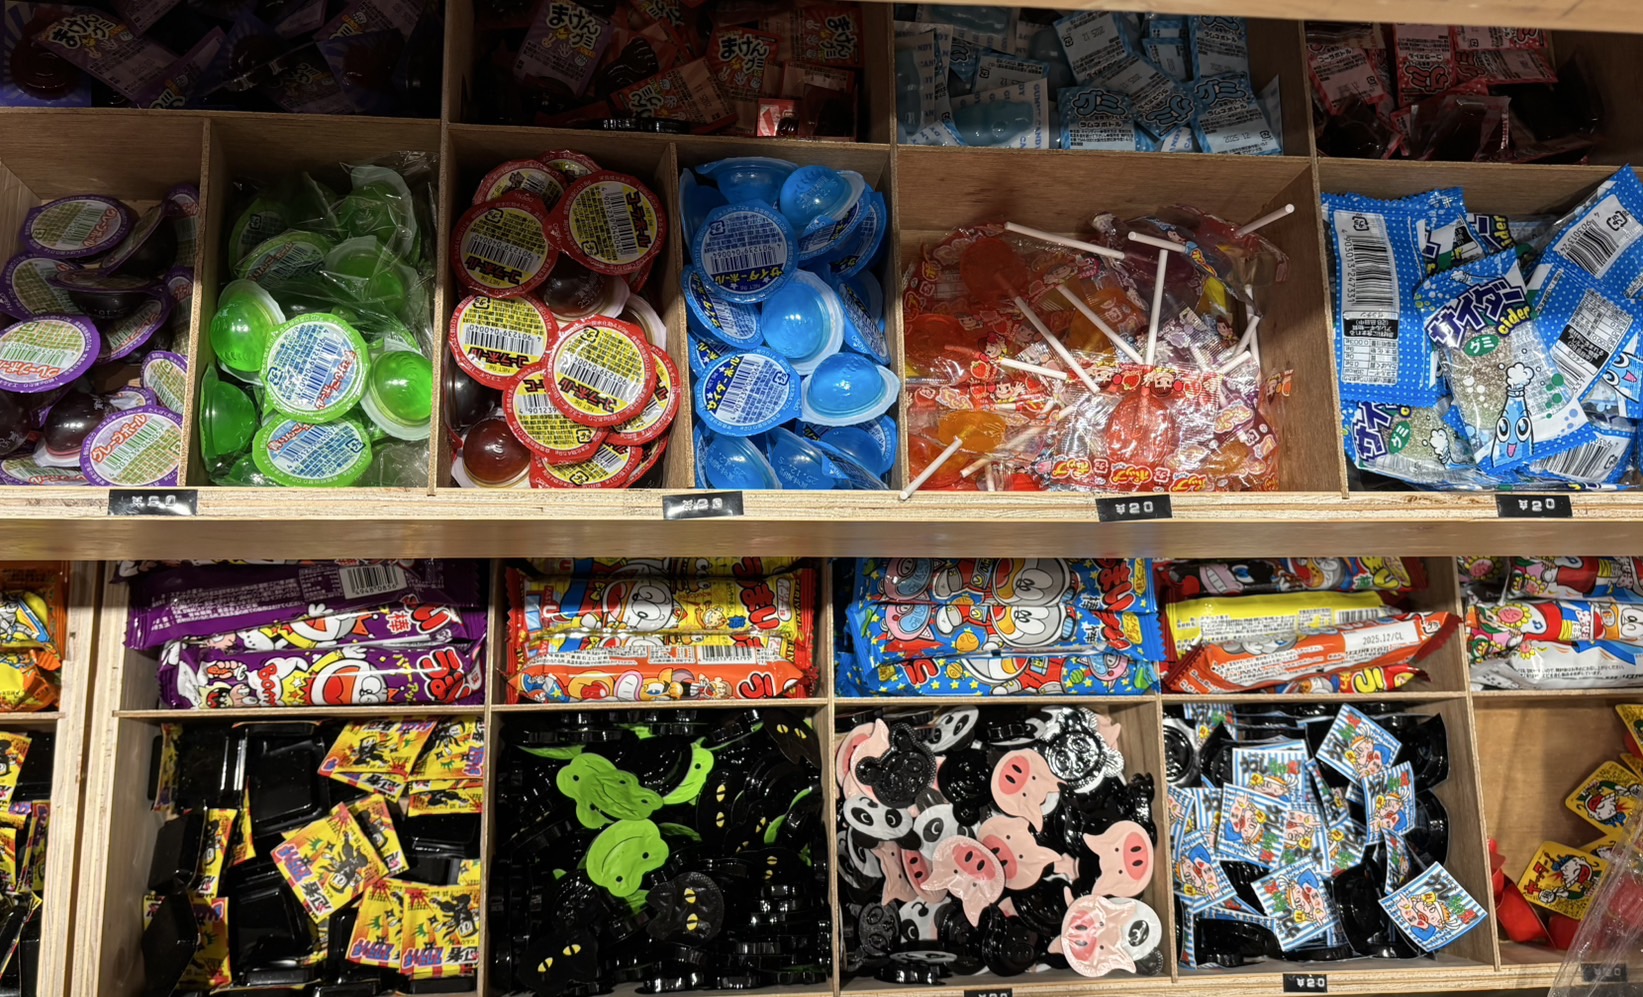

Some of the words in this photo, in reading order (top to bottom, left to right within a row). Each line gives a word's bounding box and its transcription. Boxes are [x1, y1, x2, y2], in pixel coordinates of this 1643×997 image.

[625, 191, 651, 248] コーラボール
[466, 256, 522, 286] コーラボール
[715, 267, 784, 285] サイダーボール
[1347, 267, 1357, 303] 247331
[1425, 278, 1526, 347] サイダー
[1498, 304, 1531, 335] cider
[469, 324, 500, 335] 040040
[1469, 338, 1495, 351] グミ
[574, 355, 598, 371] 04004
[706, 357, 740, 411] サイダーボール
[92, 413, 147, 465] グレープボール
[1353, 402, 1396, 461] サイ
[1390, 424, 1410, 449] グミ
[1115, 500, 1154, 515] ¥20
[1517, 497, 1556, 511] ¥20
[1296, 977, 1326, 988] ¥20
